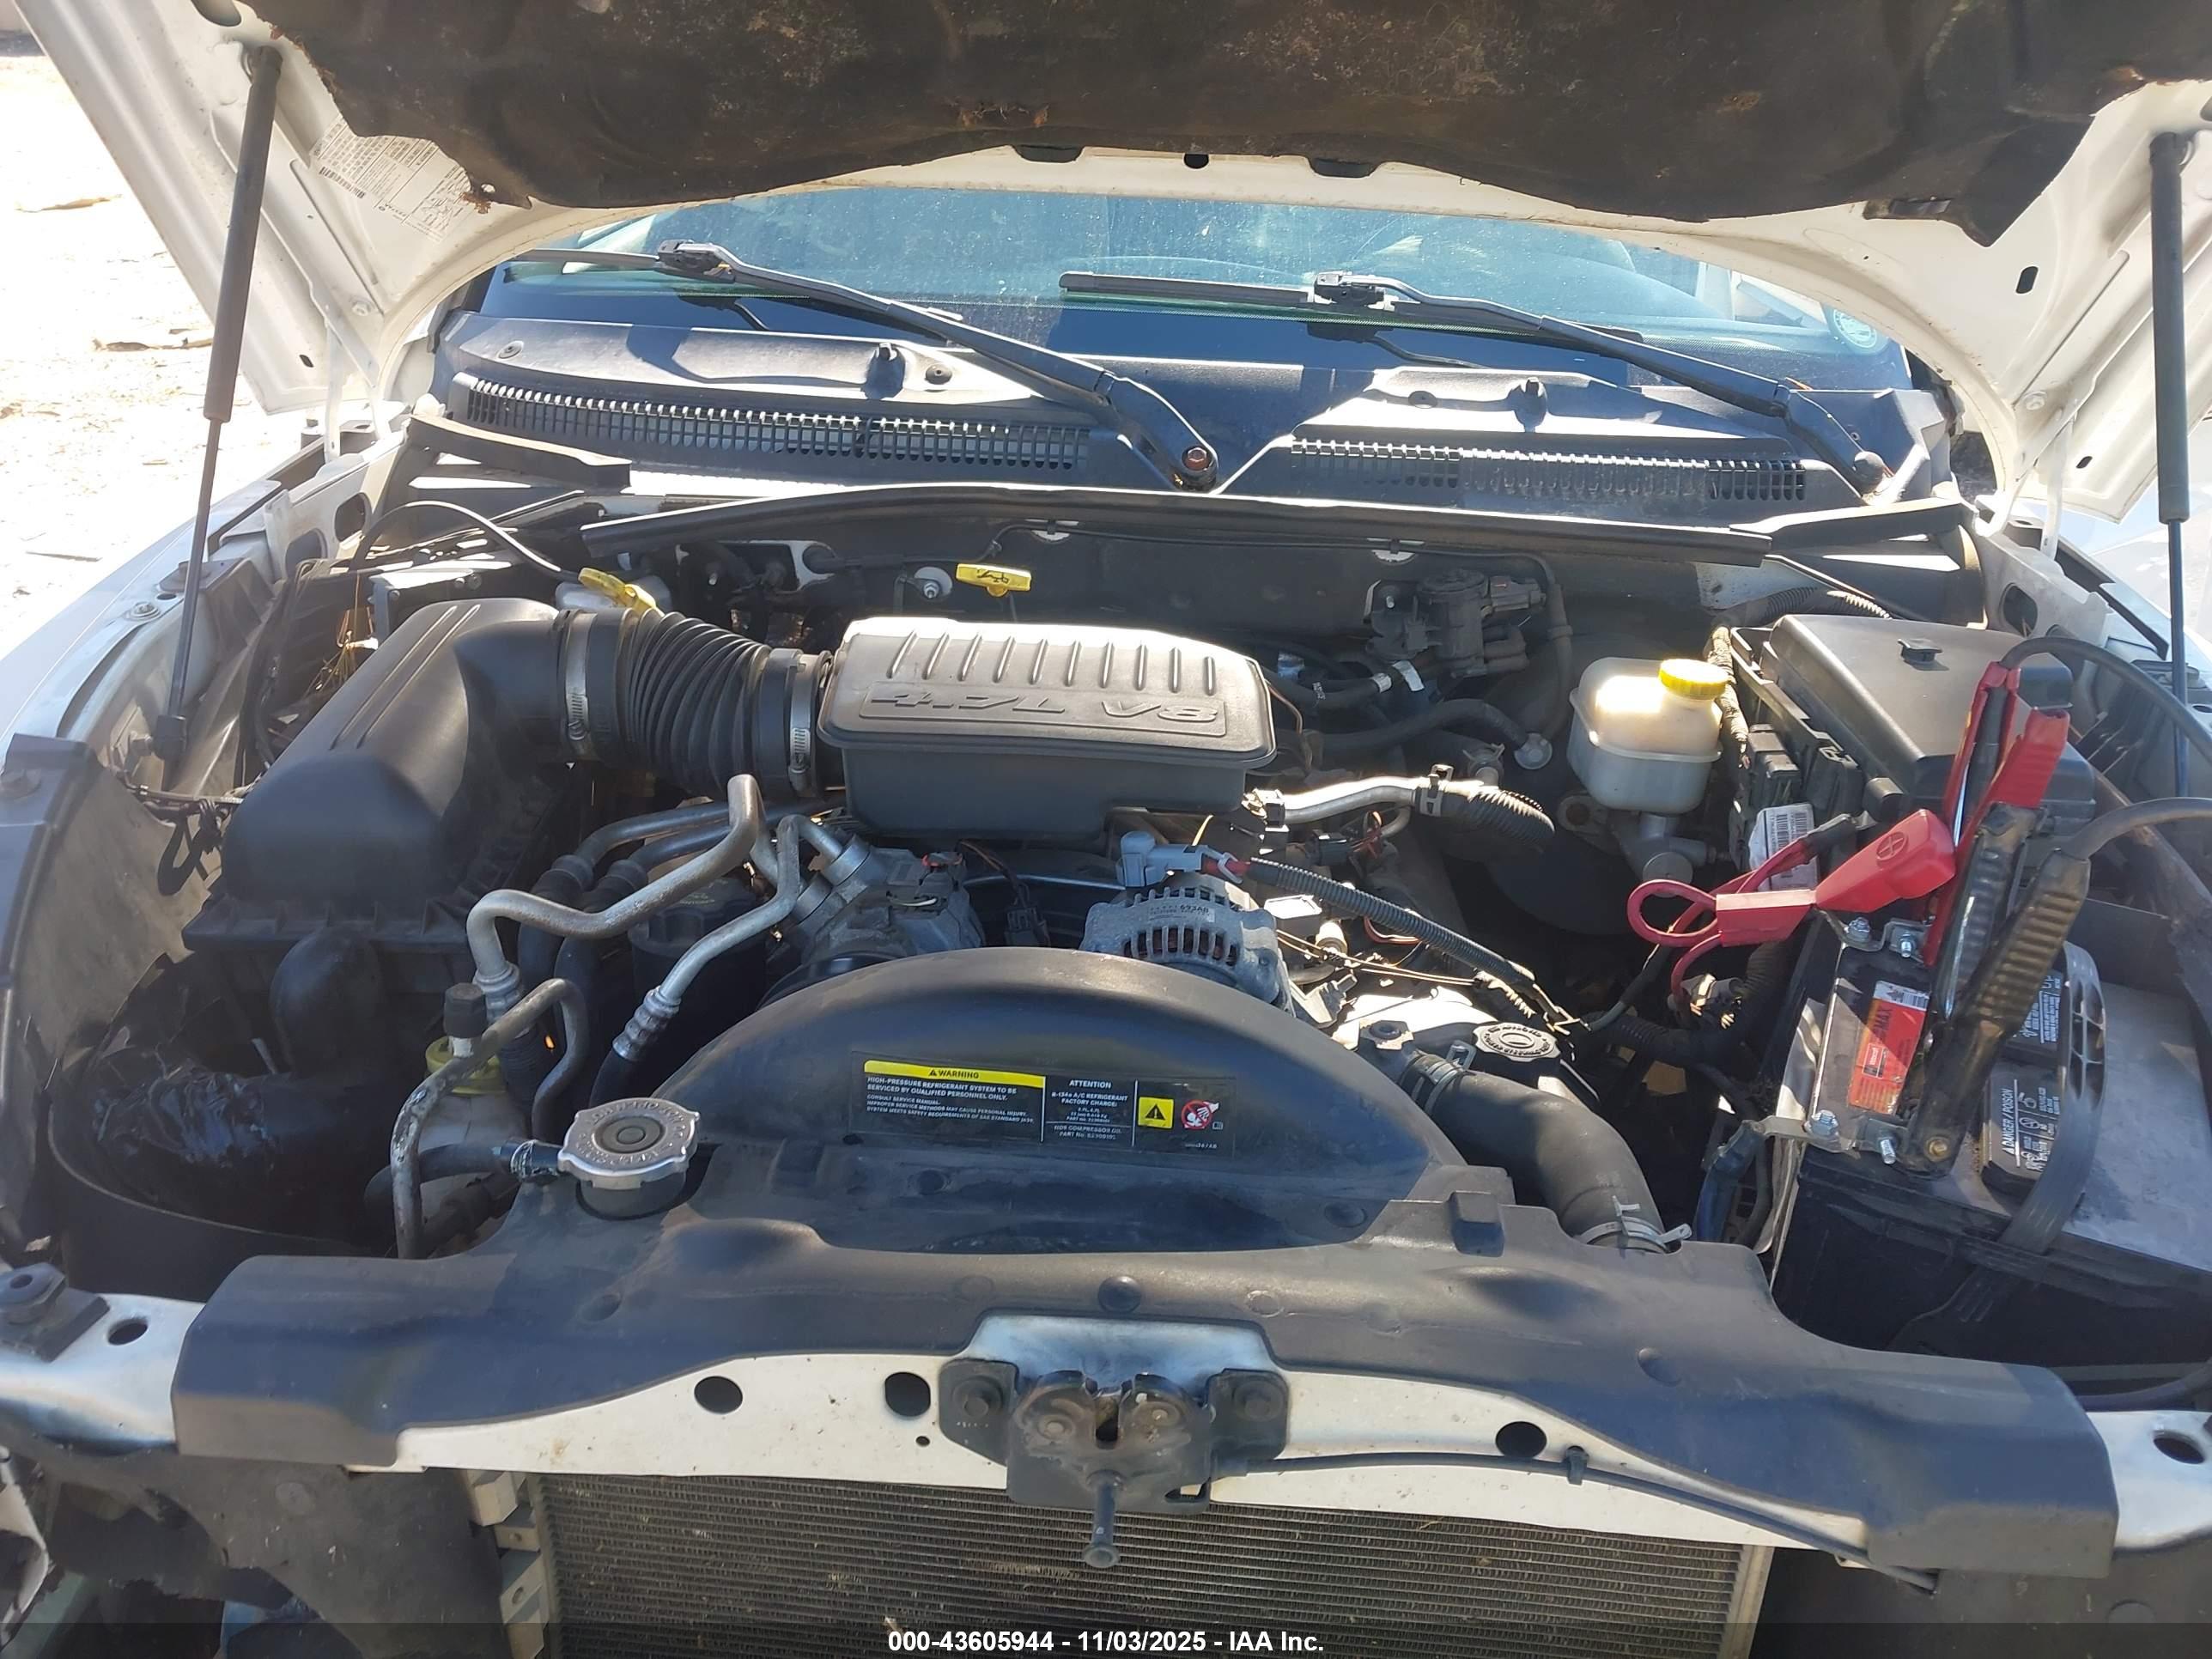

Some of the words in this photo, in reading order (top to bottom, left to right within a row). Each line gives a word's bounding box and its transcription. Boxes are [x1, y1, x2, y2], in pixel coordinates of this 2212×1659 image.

[871, 692, 1065, 714] 4.7L
[1101, 700, 1218, 723] V8
[938, 1069, 980, 1079] WARNING
[866, 1084, 900, 1092] SERVICED
[910, 1087, 946, 1097] QUALIFIED
[947, 1091, 988, 1099] PERSONNEL
[867, 1077, 921, 1087] HIGH-PRESSURE
[922, 1081, 969, 1091] REFRIGERANT
[1069, 1079, 1112, 1089] ATTENTION
[2001, 1088, 2014, 1113] POISON
[2001, 1118, 2014, 1147] DANGER
